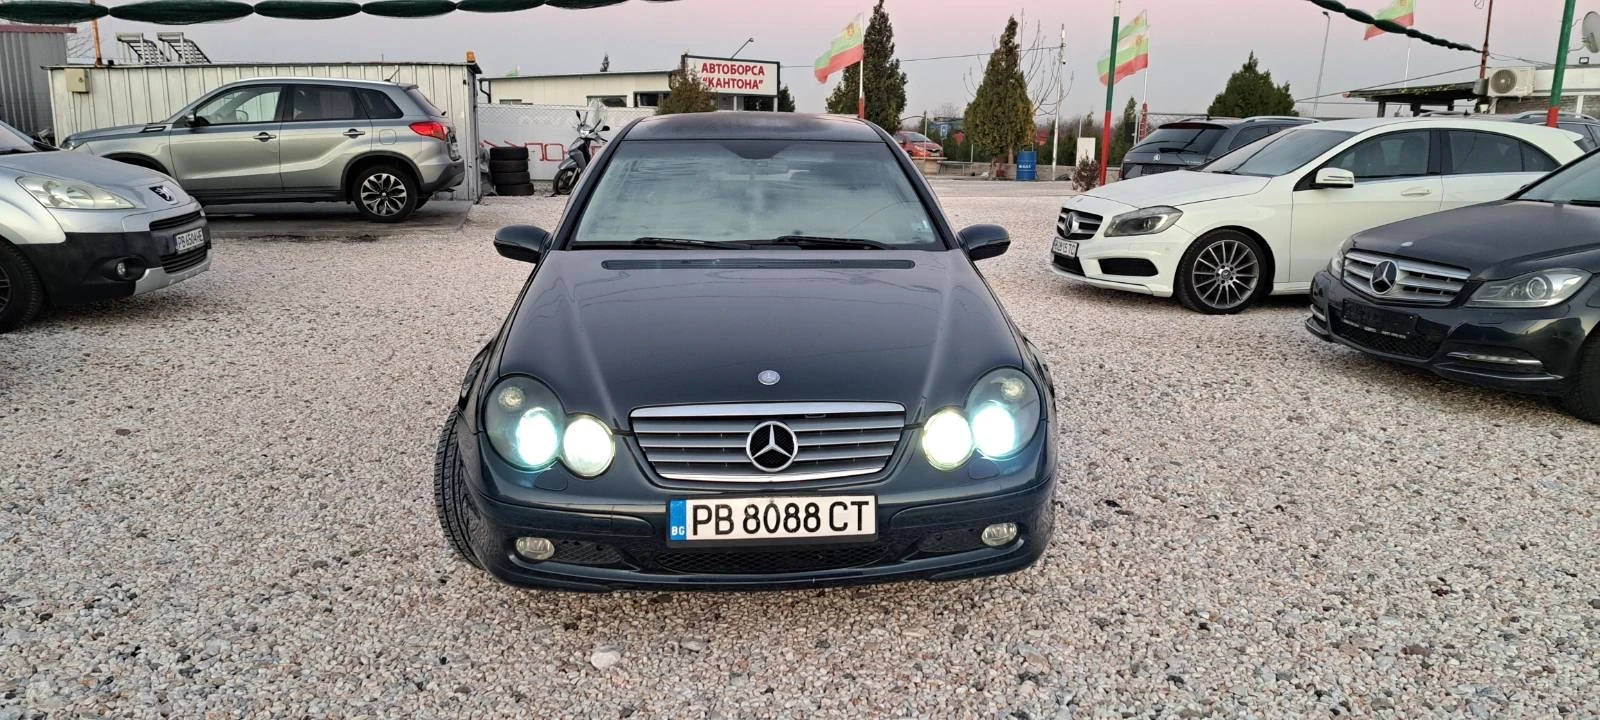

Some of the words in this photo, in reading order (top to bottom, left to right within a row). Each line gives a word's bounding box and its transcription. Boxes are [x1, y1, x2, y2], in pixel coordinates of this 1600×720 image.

[701, 62, 765, 76] АВТОБОРСА
[692, 504, 734, 536] PB
[742, 502, 821, 534] 8088
[828, 500, 869, 532] CT
[671, 526, 685, 536] BG
